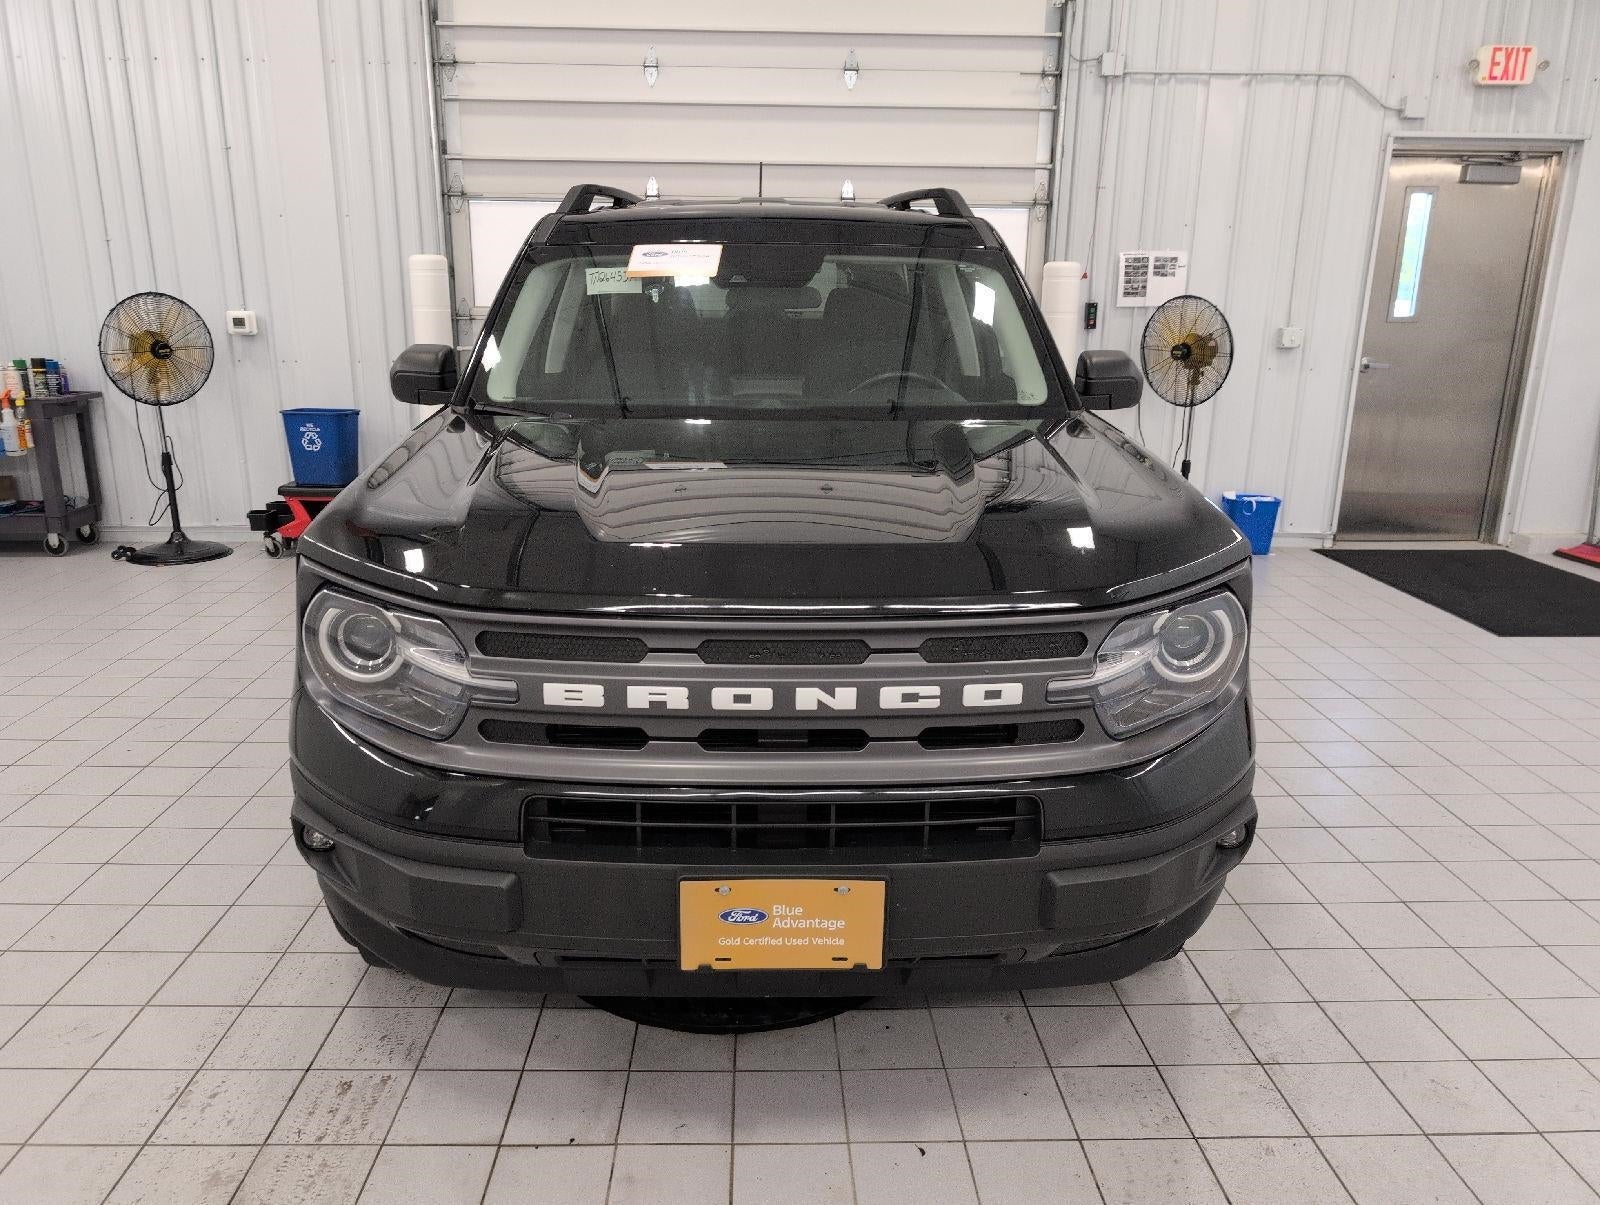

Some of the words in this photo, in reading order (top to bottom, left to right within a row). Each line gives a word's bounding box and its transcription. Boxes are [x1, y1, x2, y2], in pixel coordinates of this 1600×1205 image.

[1488, 47, 1532, 80] EXIT
[542, 682, 1025, 711] BRONCO
[726, 909, 760, 923] Ford
[772, 904, 803, 916] Blue
[772, 917, 846, 931] Advantage
[718, 937, 741, 946] Gold
[743, 936, 783, 946] Certified
[785, 937, 809, 946] Used
[811, 937, 845, 946] Vehicle
